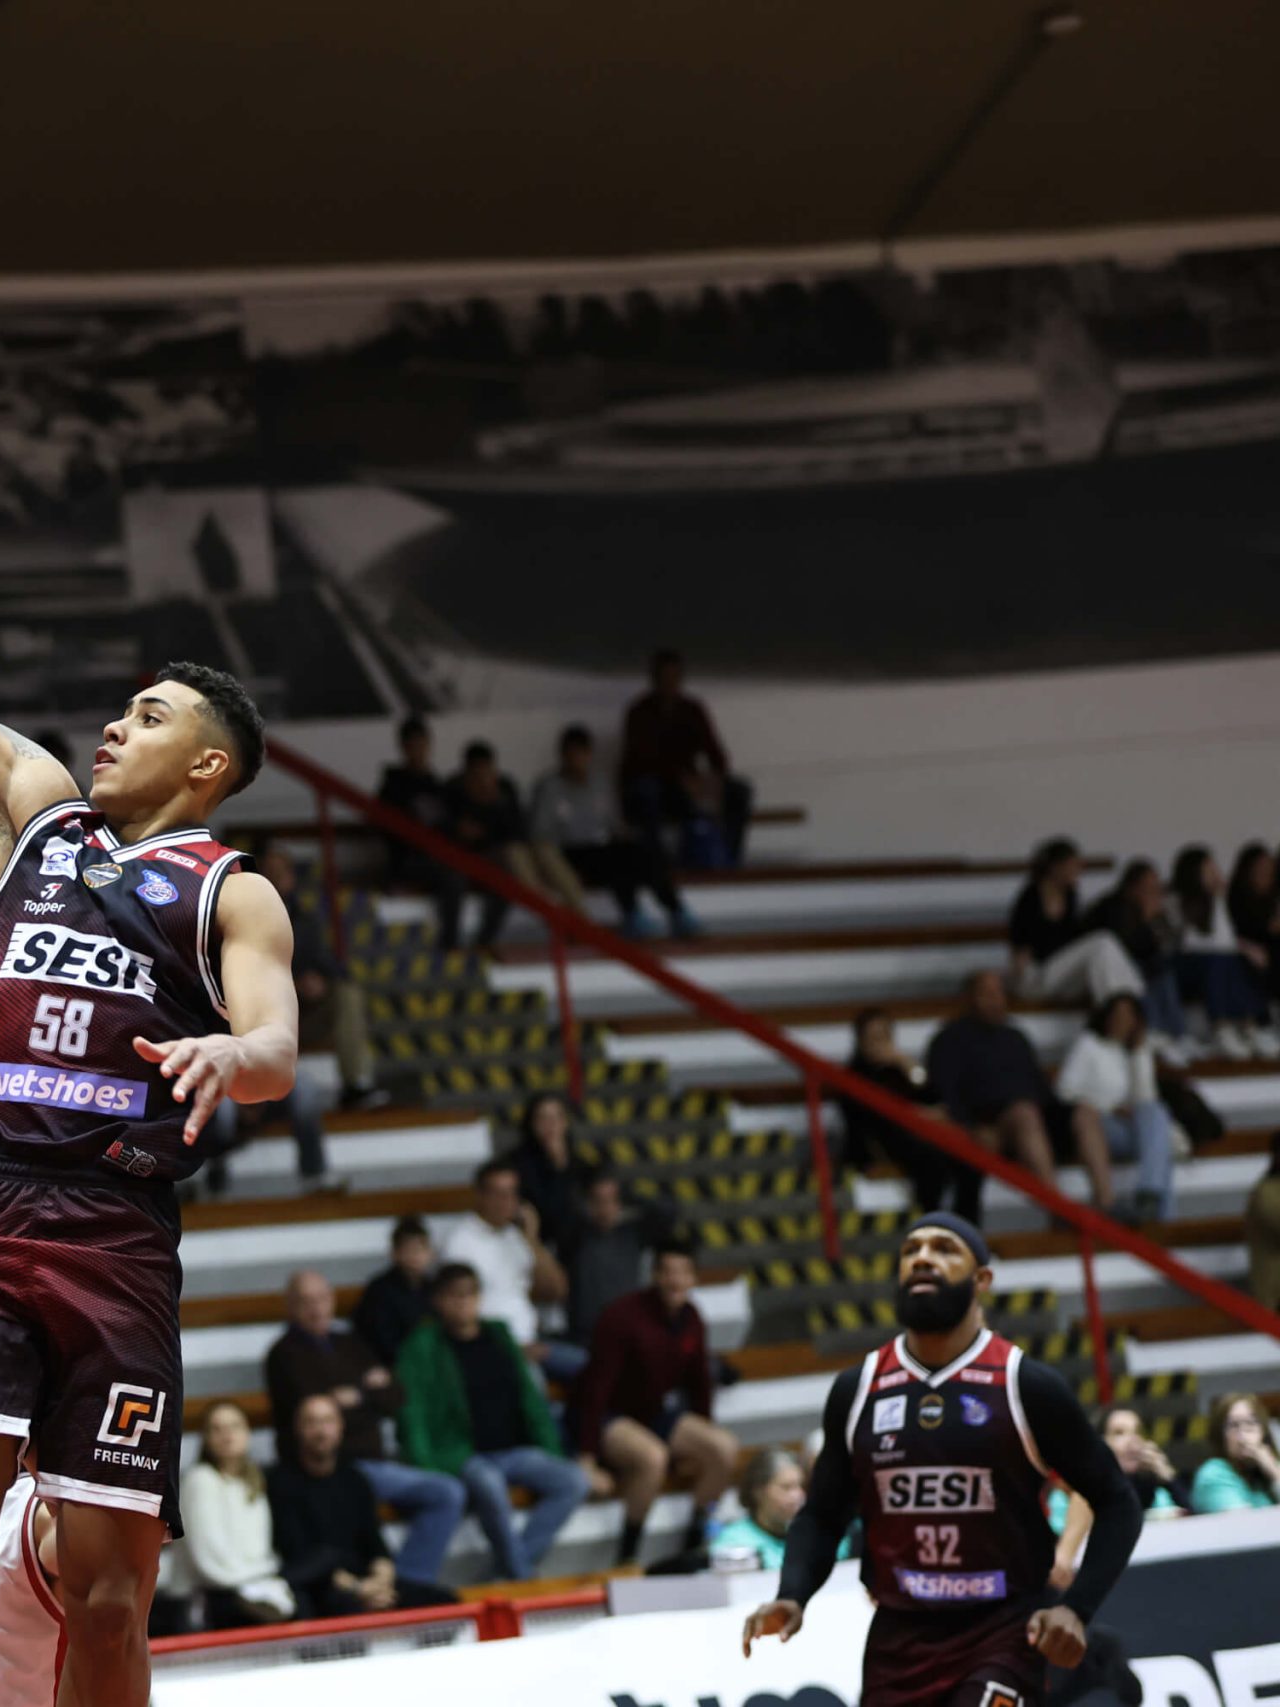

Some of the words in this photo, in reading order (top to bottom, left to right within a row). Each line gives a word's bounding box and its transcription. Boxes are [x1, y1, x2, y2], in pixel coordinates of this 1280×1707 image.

[23, 900, 66, 915] Topper
[13, 931, 139, 989] SESI
[29, 994, 94, 1057] 58
[93, 1448, 160, 1471] FREEWAY
[889, 1472, 981, 1508] SESI
[915, 1524, 962, 1566] 32
[902, 1573, 995, 1597] etshoes
